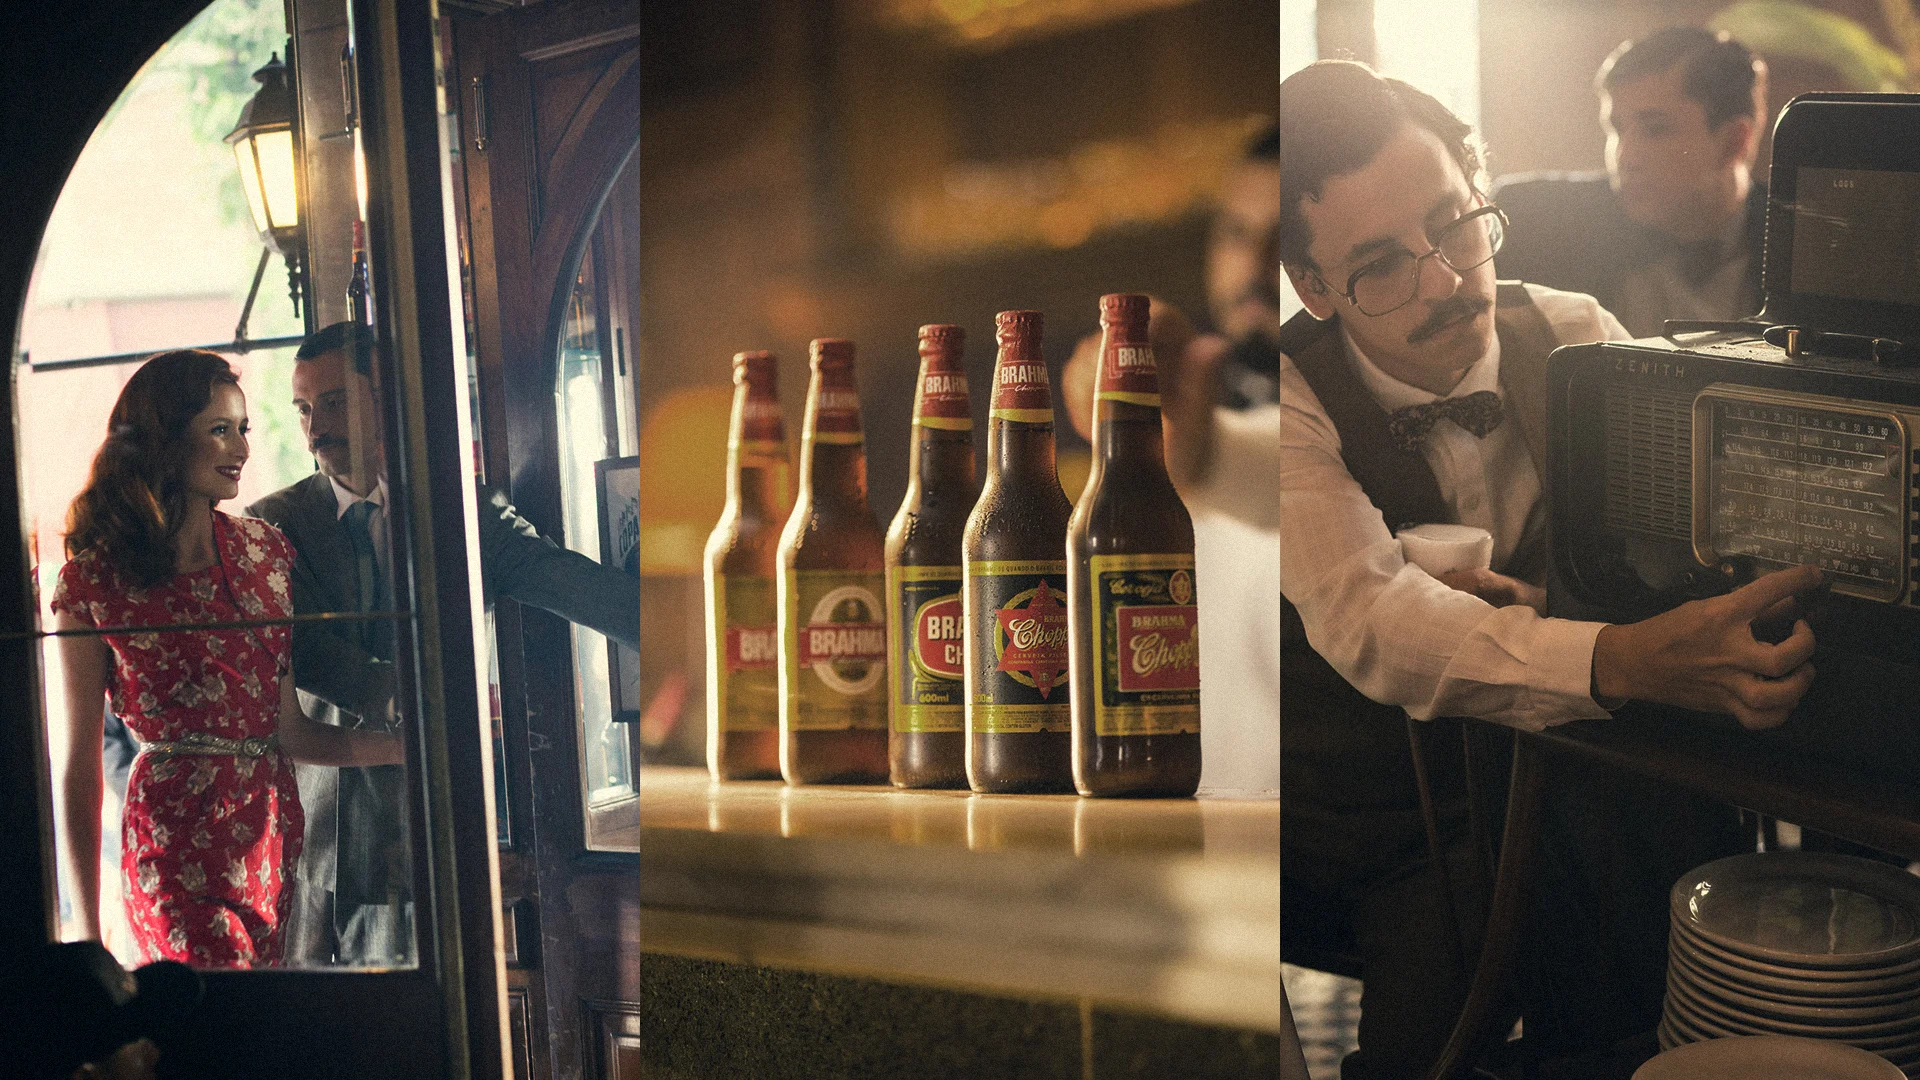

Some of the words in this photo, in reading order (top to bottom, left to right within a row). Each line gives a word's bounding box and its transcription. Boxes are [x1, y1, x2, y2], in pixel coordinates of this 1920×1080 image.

[1615, 359, 1685, 378] ZENITH
[927, 616, 963, 640] BRA
[1132, 615, 1186, 628] BRAHMA
[810, 629, 884, 656] BRAHMA
[1008, 618, 1068, 650] Chopp
[919, 693, 949, 703] 600ml
